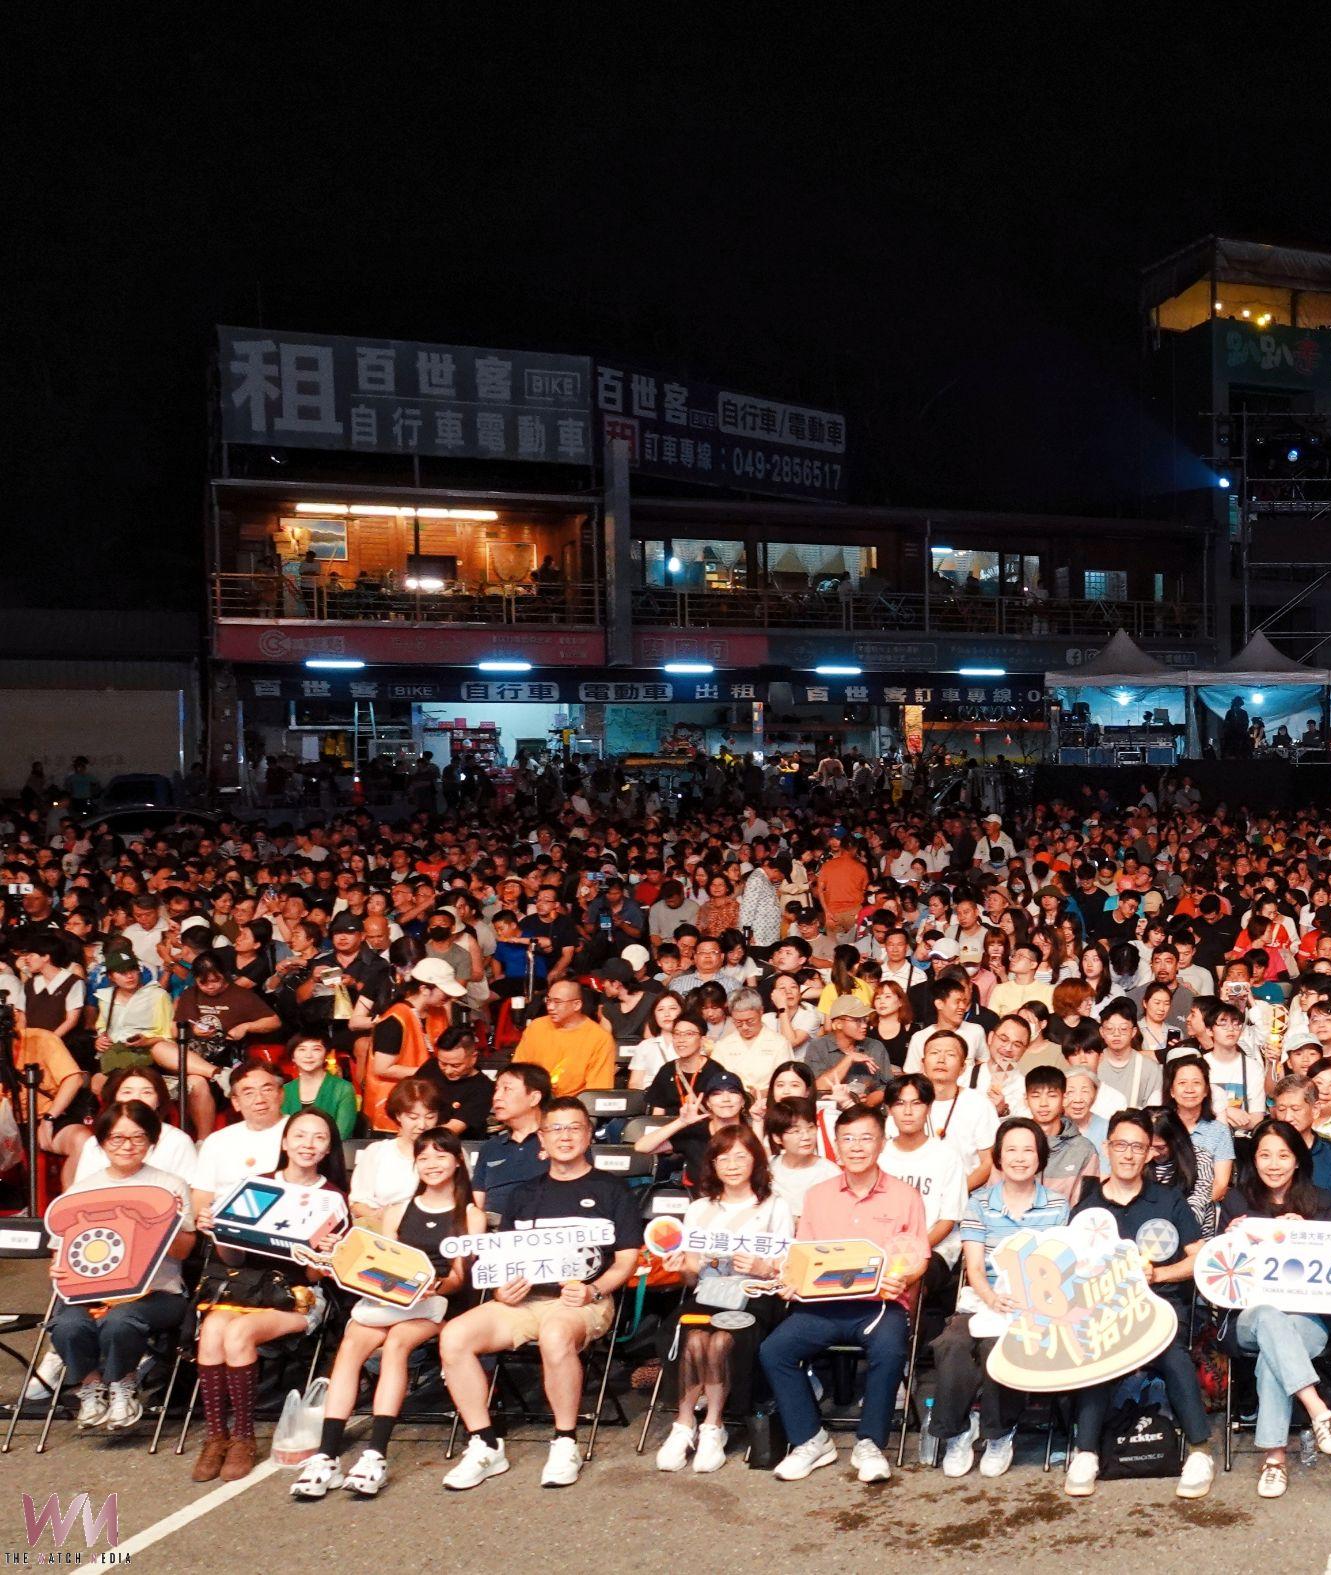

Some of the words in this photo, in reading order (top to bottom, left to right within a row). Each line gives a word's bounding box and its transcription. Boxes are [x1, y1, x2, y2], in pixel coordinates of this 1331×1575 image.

[230, 340, 343, 434] 租
[356, 346, 512, 399] 百世客
[532, 375, 575, 396] BIKE
[597, 365, 690, 427] 百世客
[351, 404, 586, 458] 自行車電動車
[253, 680, 379, 698] 百世客
[394, 686, 433, 697] BIKE
[465, 683, 555, 700] 自行車
[584, 684, 669, 700] 電動車
[695, 683, 755, 699] 出租
[445, 1236, 501, 1254] OPEN
[514, 1229, 610, 1247] POSSIBLE
[689, 1230, 789, 1256] 台灣大哥大
[992, 1235, 1072, 1319] 18
[1008, 1281, 1151, 1366] 十八拾光
